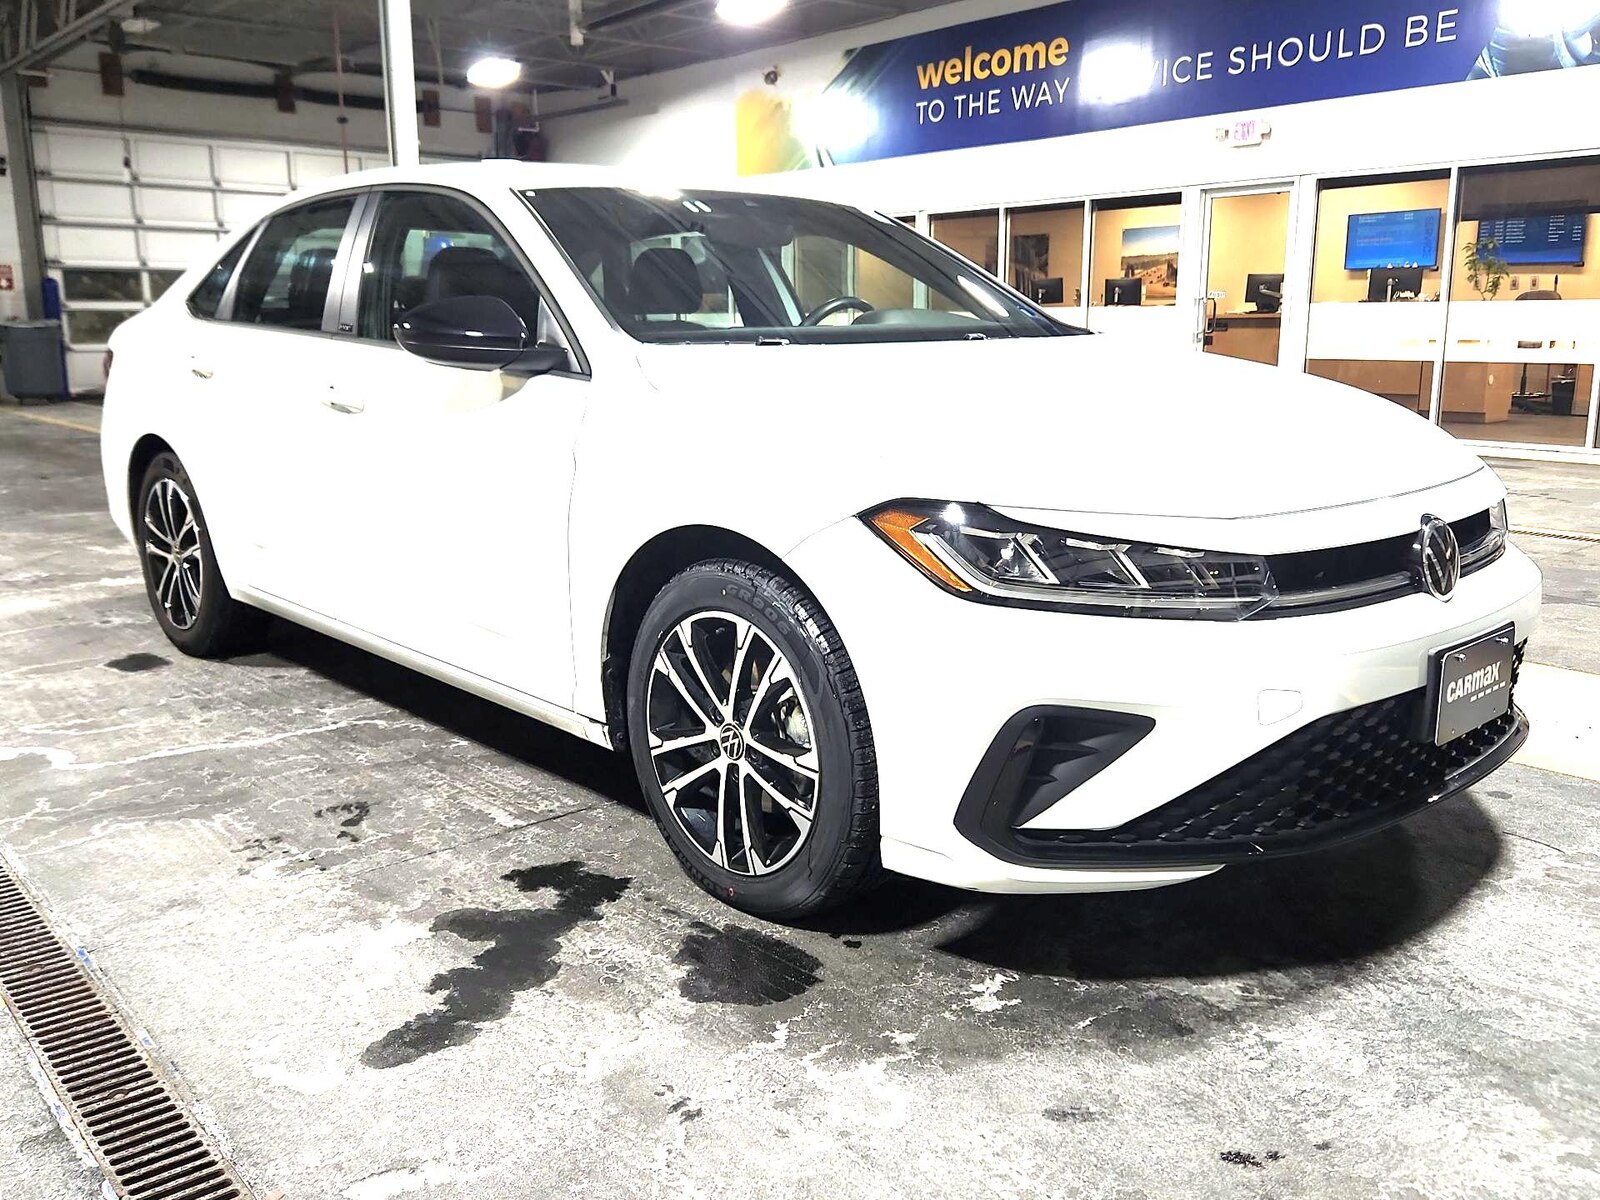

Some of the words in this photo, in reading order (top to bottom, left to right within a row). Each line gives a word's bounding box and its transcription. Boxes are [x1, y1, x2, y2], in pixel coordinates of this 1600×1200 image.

[915, 99, 945, 126] TO
[953, 89, 1001, 119] THE
[1011, 77, 1072, 111] WAY
[1227, 23, 1386, 76] SHOULD
[1404, 8, 1459, 48] BE
[916, 36, 1070, 90] welcome
